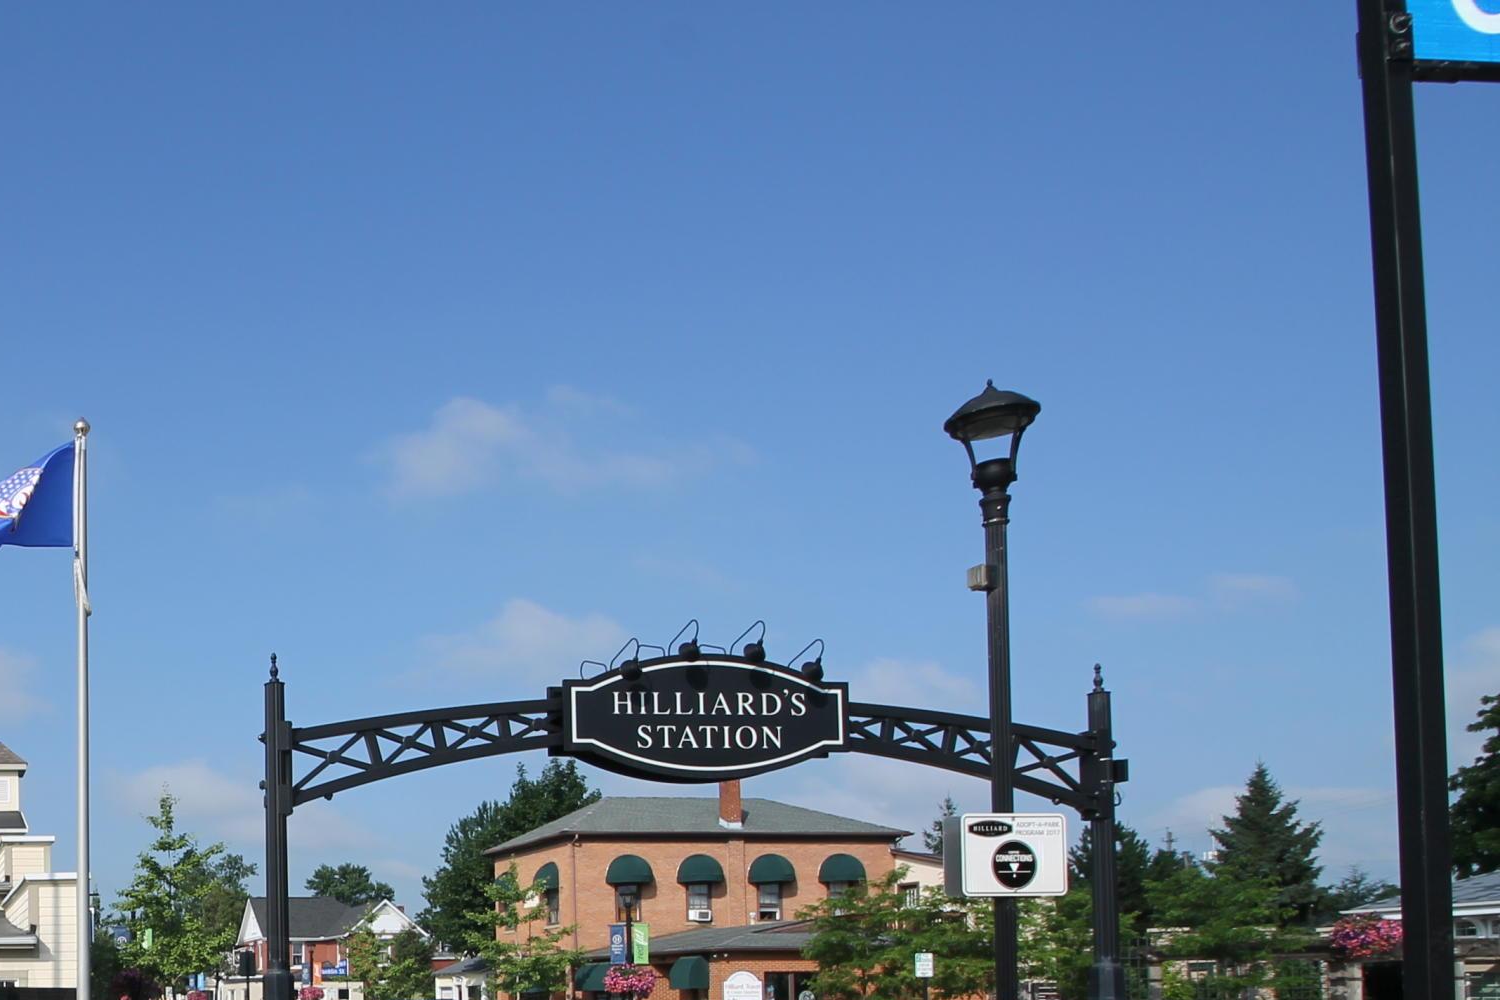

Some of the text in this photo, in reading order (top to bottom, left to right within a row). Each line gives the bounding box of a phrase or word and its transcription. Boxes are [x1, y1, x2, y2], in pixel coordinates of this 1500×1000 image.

[612, 688, 807, 717] HILLIARD'S
[637, 724, 783, 750] STATION
[995, 854, 1033, 862] CONNECTIONS
